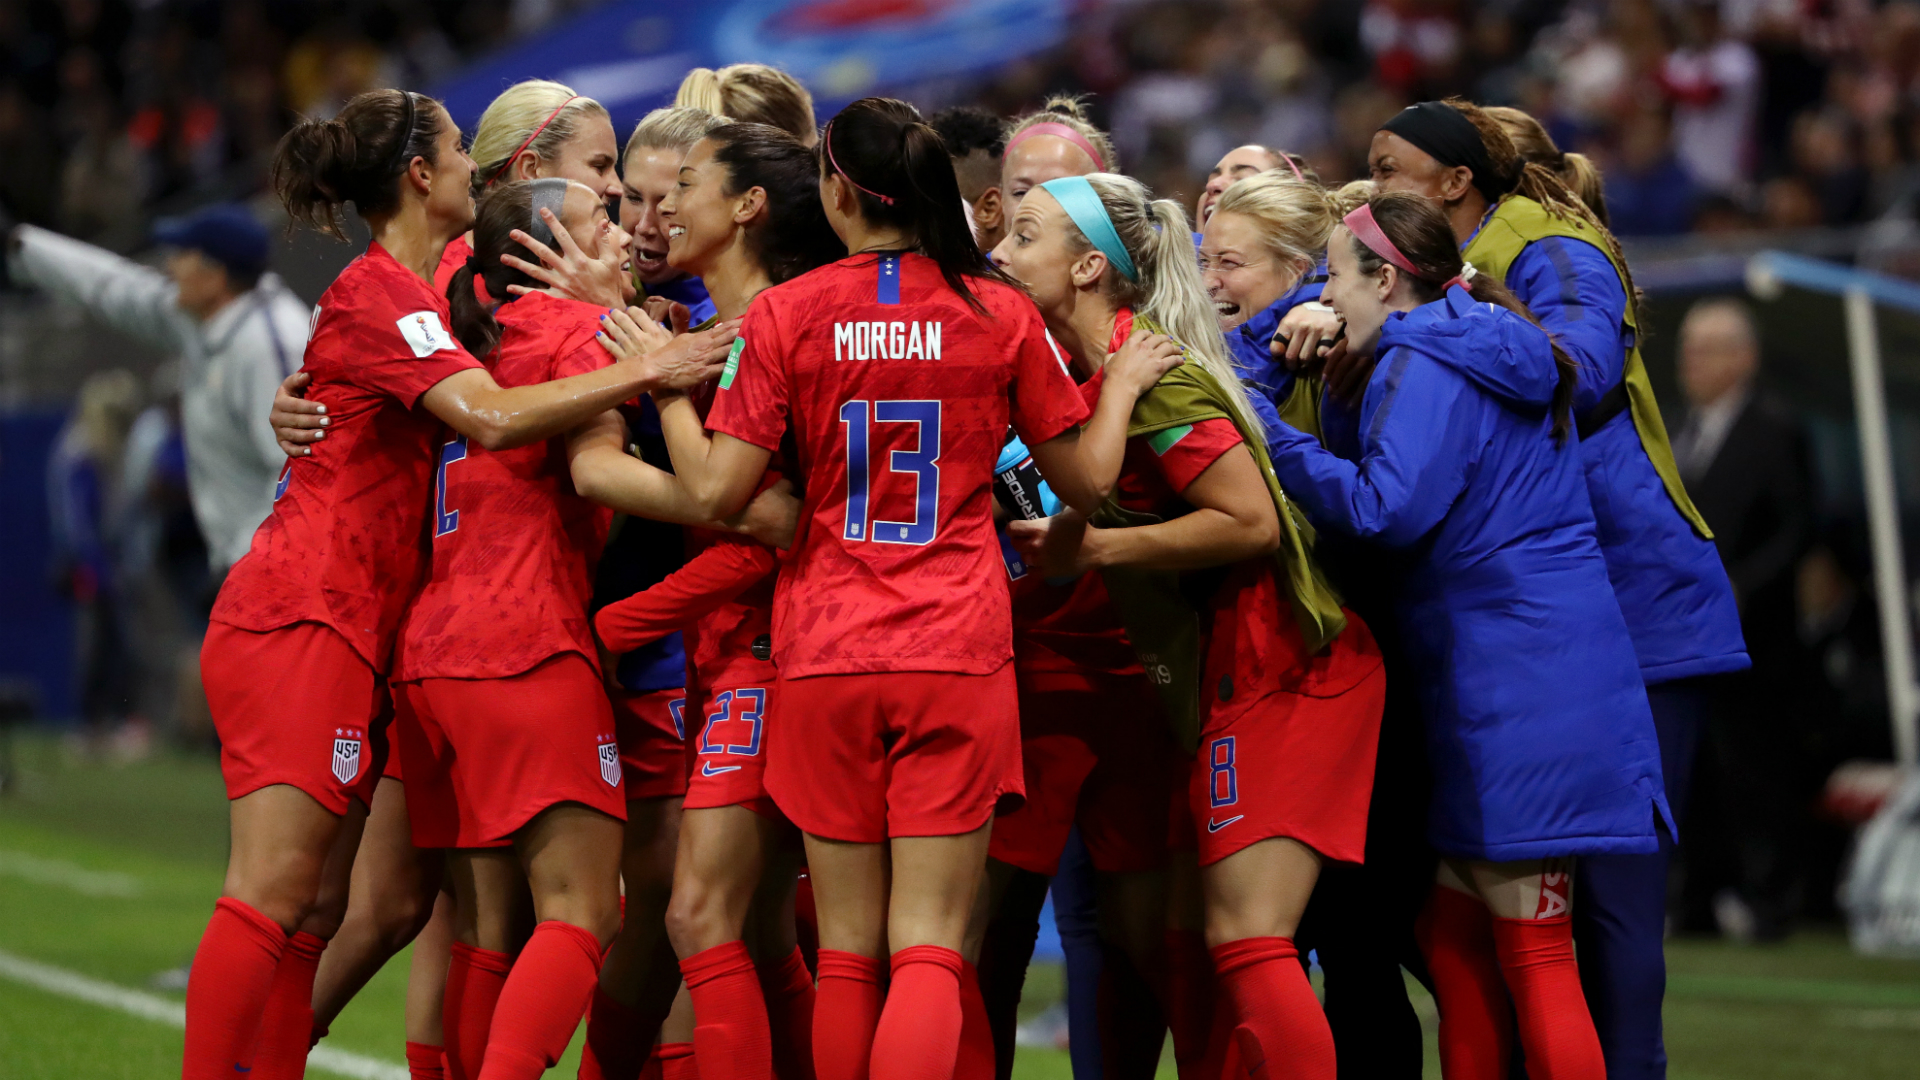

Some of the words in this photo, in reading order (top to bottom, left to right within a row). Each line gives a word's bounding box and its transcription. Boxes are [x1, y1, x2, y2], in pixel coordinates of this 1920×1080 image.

[834, 321, 942, 361] MORGAN
[840, 400, 942, 546] 13
[1144, 664, 1172, 685] 019
[698, 687, 766, 757] 23
[336, 741, 359, 759] USA
[600, 744, 617, 763] USA
[1210, 735, 1238, 809] 8
[1537, 858, 1569, 920] SA
